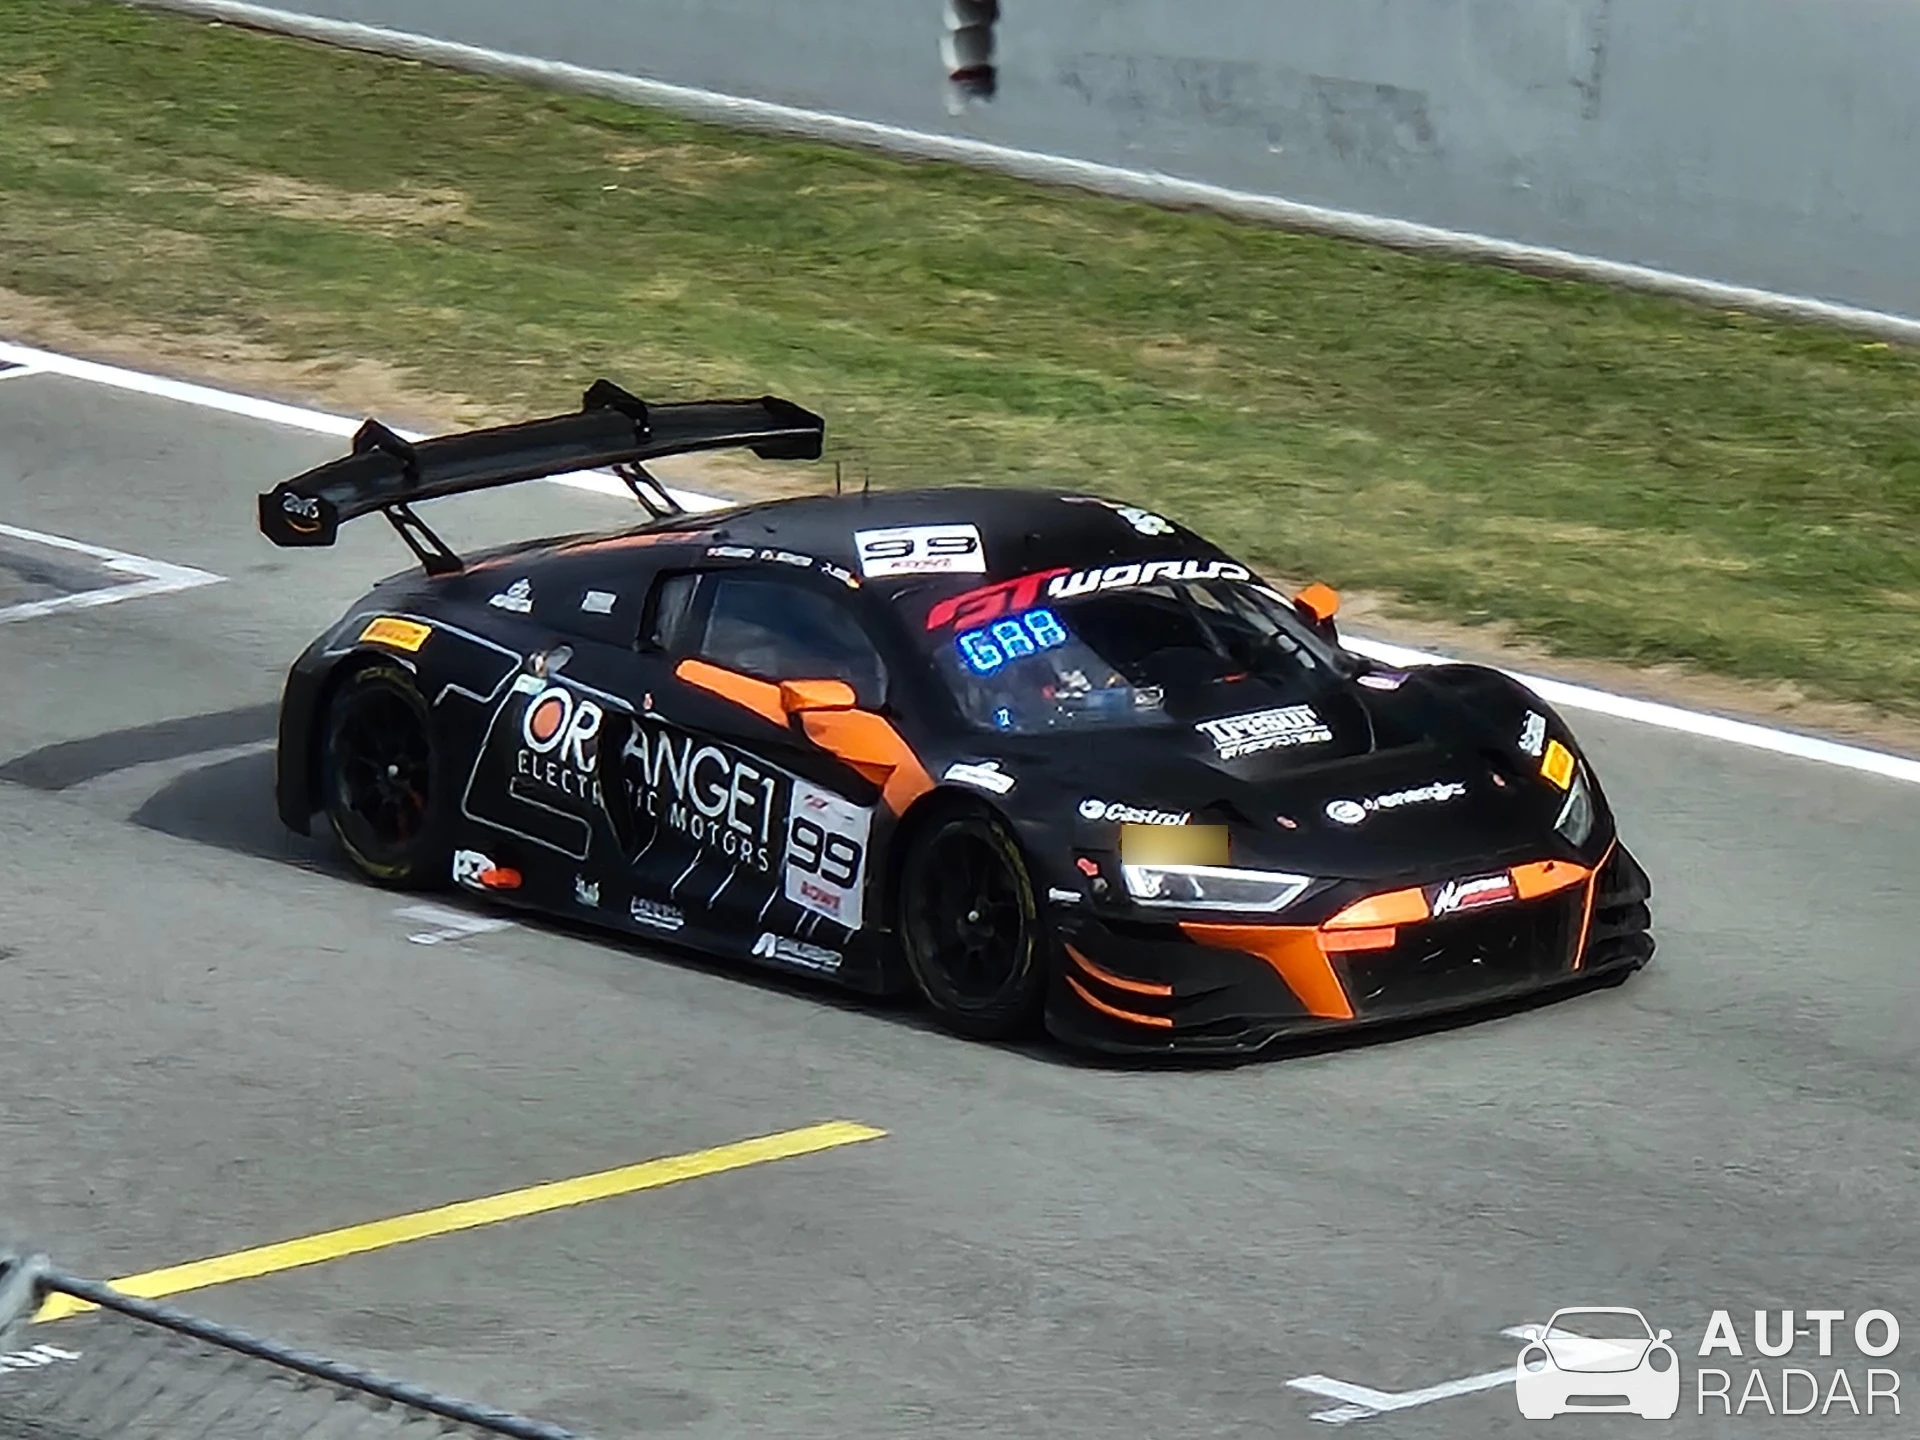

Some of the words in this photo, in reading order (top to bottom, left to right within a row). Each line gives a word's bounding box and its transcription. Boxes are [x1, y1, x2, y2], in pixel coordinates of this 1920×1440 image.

[864, 536, 977, 561] 99
[669, 802, 770, 872] MOTORS
[1104, 803, 1191, 825] Castrol
[787, 816, 863, 890] 99
